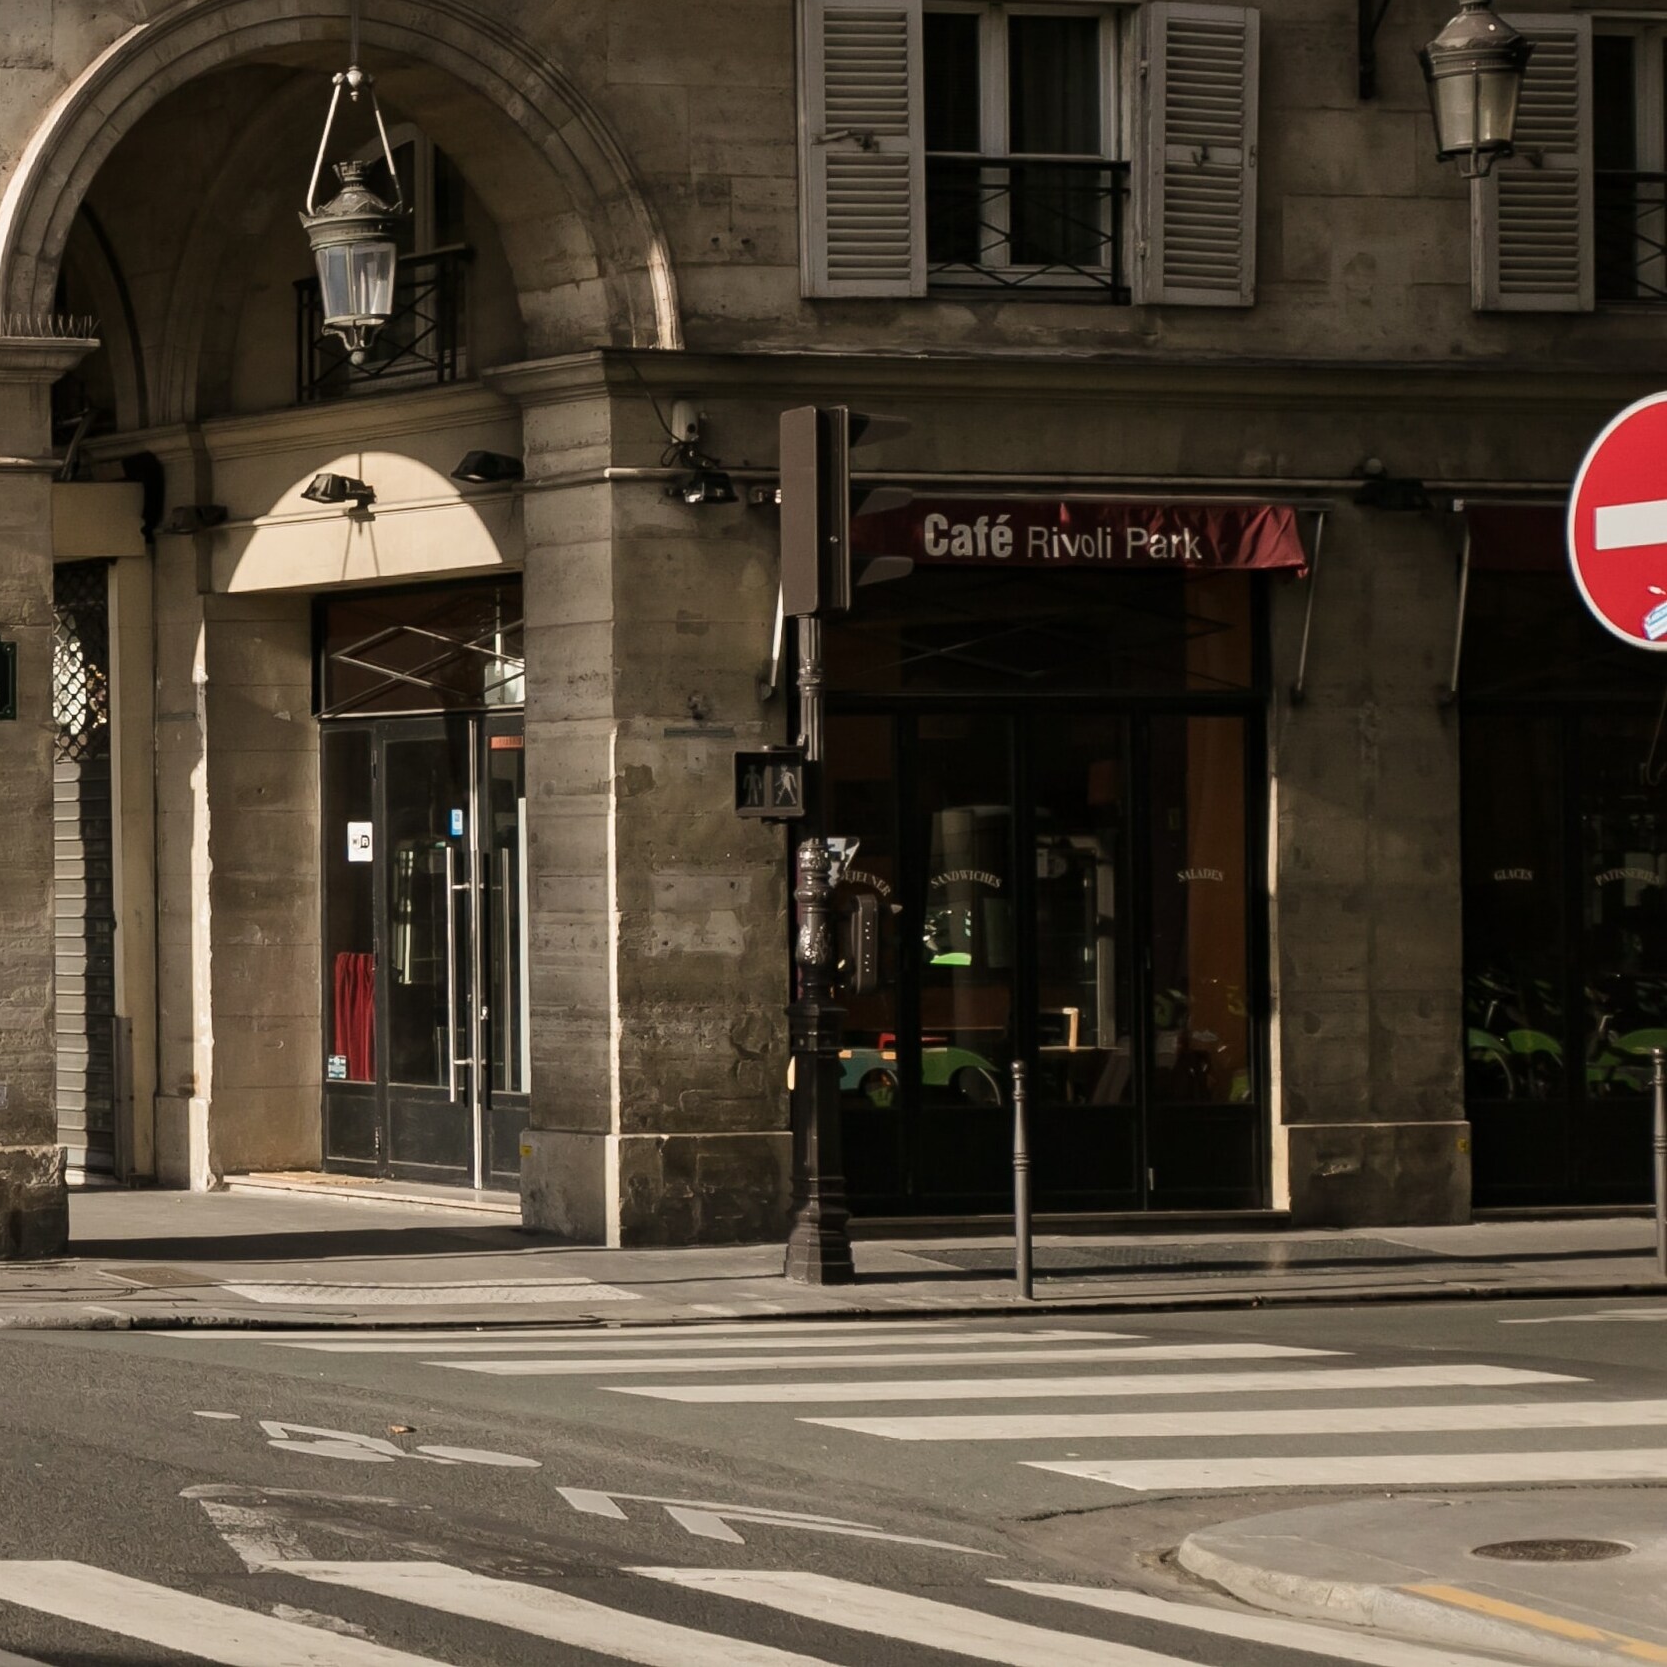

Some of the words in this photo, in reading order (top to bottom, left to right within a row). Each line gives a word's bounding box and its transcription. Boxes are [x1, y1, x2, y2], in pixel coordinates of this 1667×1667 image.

[923, 512, 1014, 558] Café
[1027, 526, 1112, 559] Rivoli
[1126, 526, 1203, 560] Park
[930, 869, 1003, 889] SANDWICHES
[1176, 867, 1224, 882] SALADES
[1493, 867, 1534, 882] GLACES
